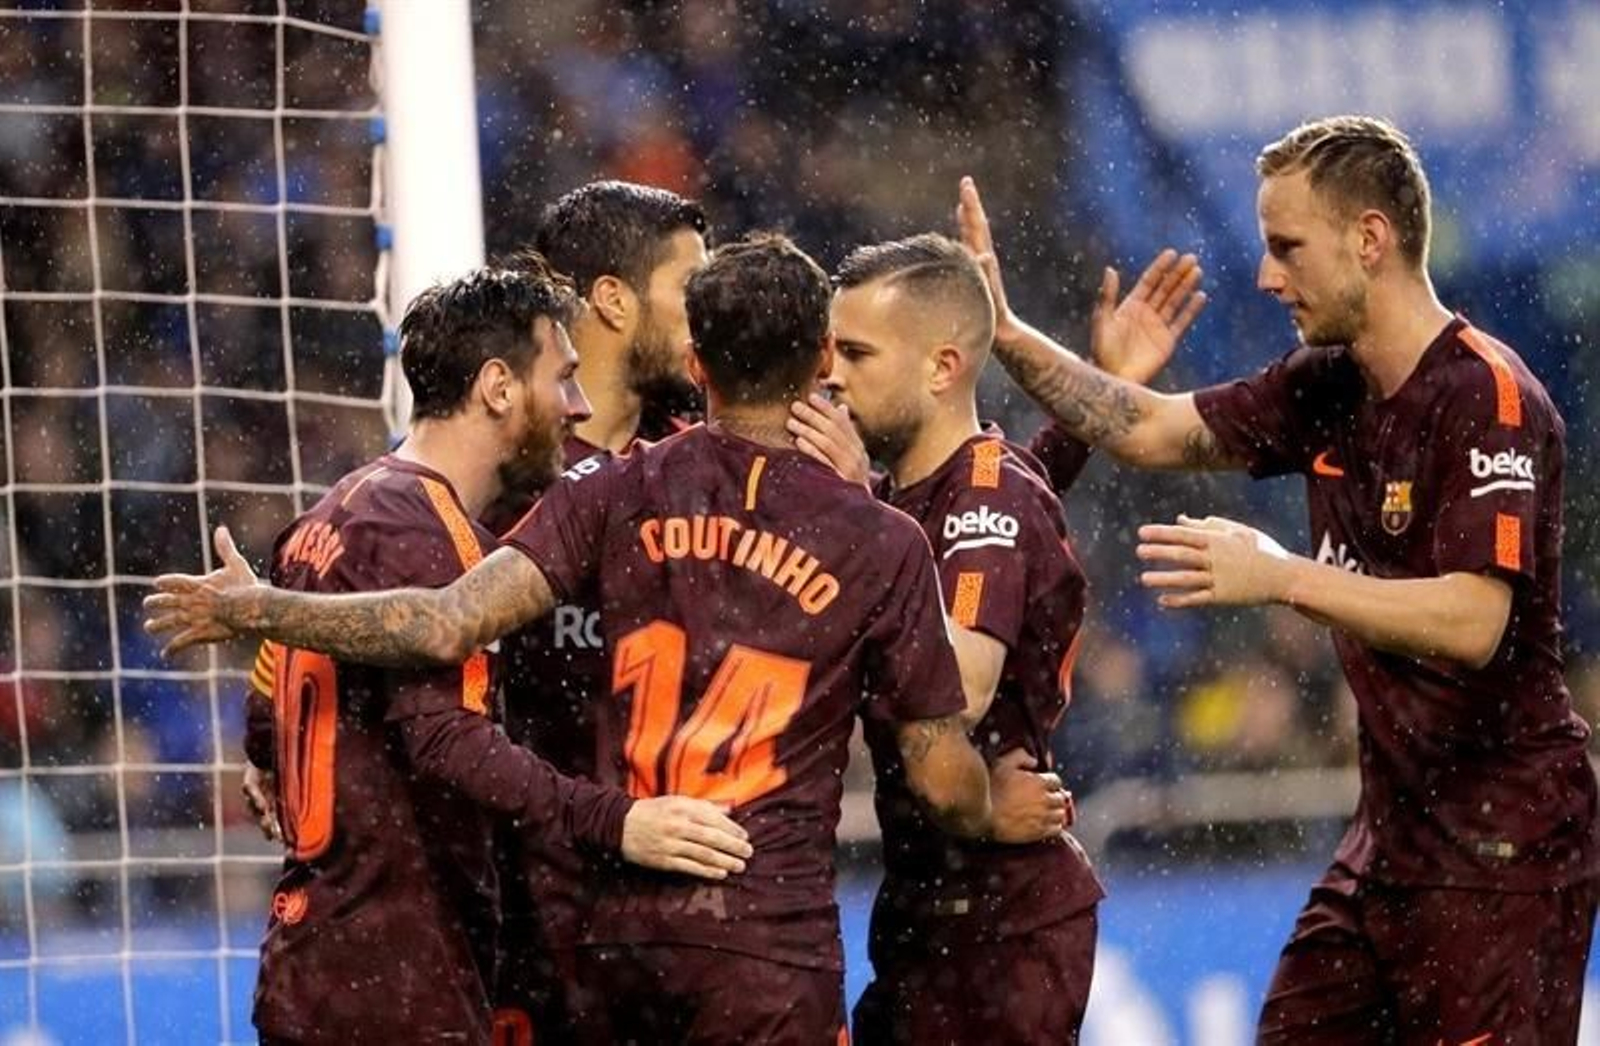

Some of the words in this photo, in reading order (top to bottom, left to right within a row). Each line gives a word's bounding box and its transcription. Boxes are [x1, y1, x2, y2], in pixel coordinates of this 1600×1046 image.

[640, 515, 840, 615] COUTINHO
[943, 505, 1019, 539] beko
[612, 619, 812, 810] 14
